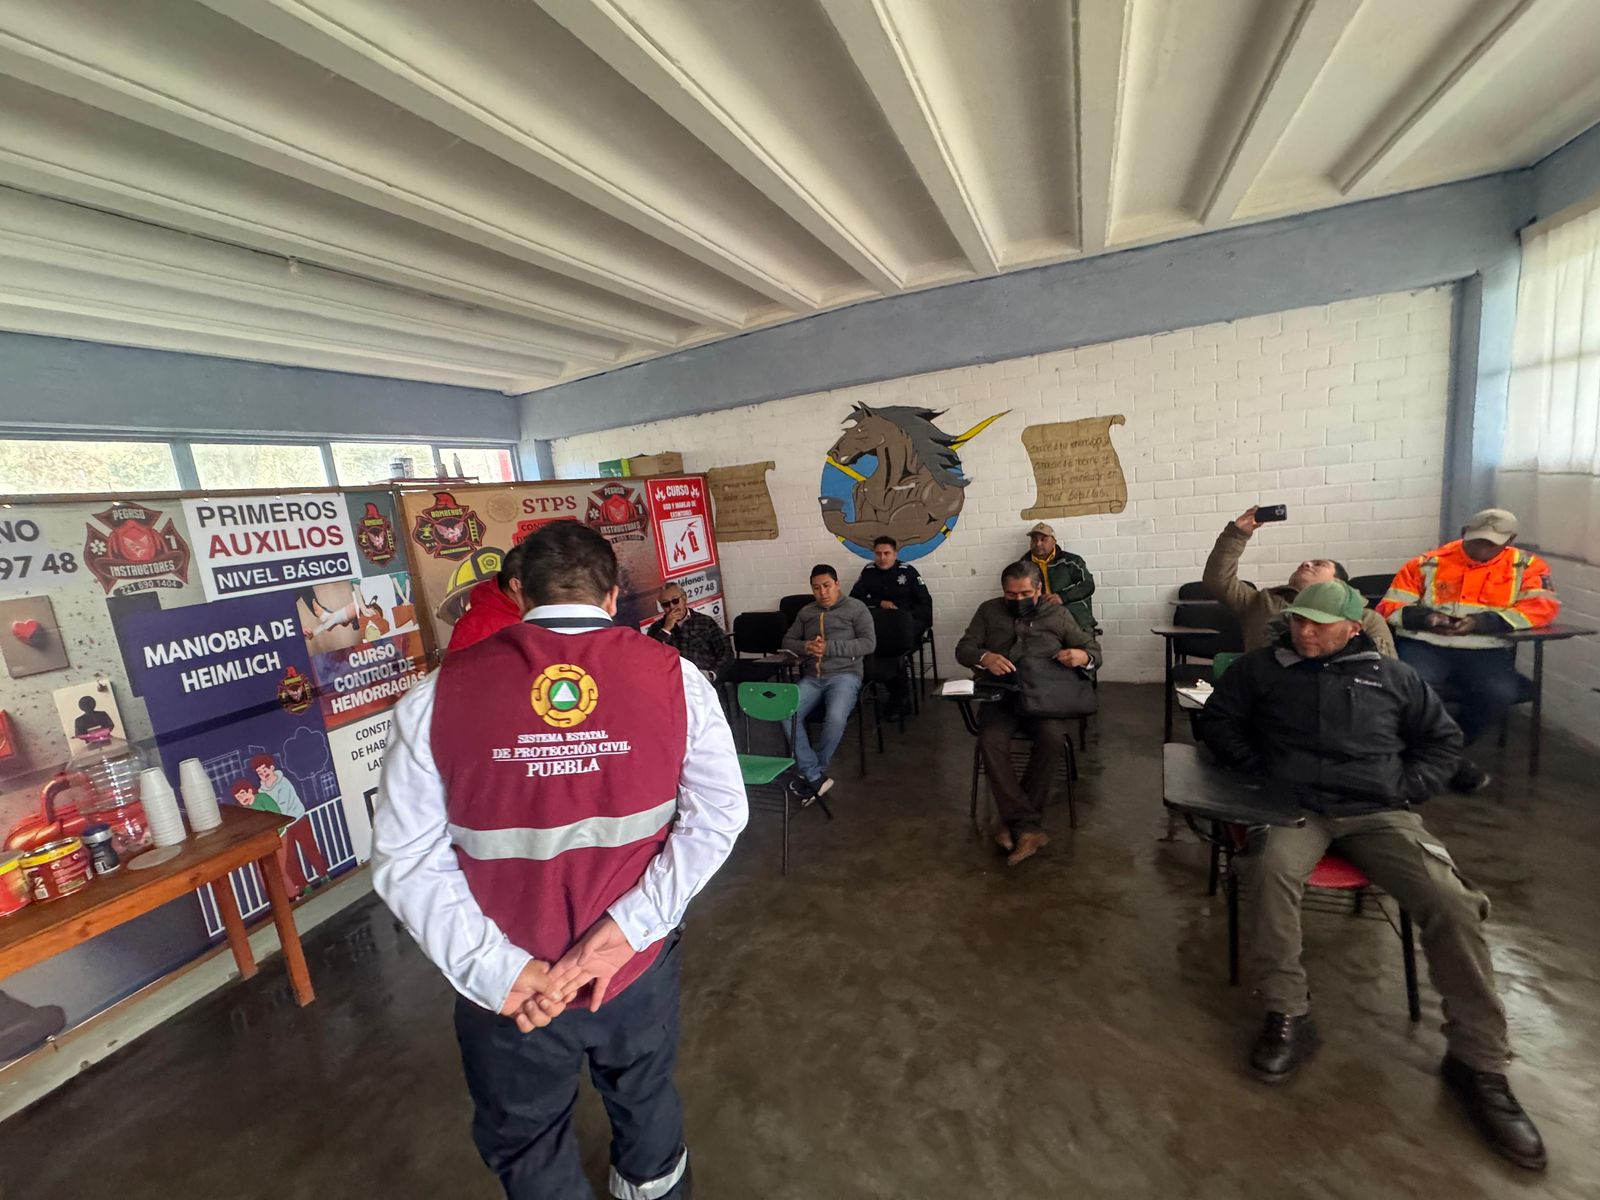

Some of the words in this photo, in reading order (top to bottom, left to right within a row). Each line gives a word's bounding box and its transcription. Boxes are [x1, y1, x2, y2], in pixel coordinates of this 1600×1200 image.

[666, 484, 689, 497] CURSO
[112, 508, 146, 520] PEGASO
[196, 500, 338, 528] PRIMEROS
[522, 495, 577, 514] STPS
[208, 525, 344, 559] AUXILIOS
[0, 555, 33, 580] 97
[41, 552, 79, 575] 48
[110, 560, 175, 577] INSTRUCTORES
[216, 567, 279, 590] NIVEL
[282, 557, 350, 580] BÁSICO
[694, 585, 704, 596] 97
[705, 582, 715, 591] 48
[143, 624, 270, 668] MANIOBRA
[269, 618, 296, 641] DE
[349, 643, 396, 668] CURSO
[181, 651, 282, 693] HEIMLICH
[334, 662, 398, 693] CONTROL
[399, 656, 416, 673] DE
[331, 671, 426, 714] HEMORRAGIAS
[355, 719, 392, 741] CONSTA
[517, 733, 563, 744] SISTEMA
[565, 730, 609, 741] ESTATAL
[351, 747, 364, 761] DE
[366, 738, 387, 757] HAB
[492, 748, 512, 759] DE
[513, 742, 597, 758] PROTECCIÓN
[598, 740, 631, 752] CIVIL
[526, 758, 600, 777] PUEBLA
